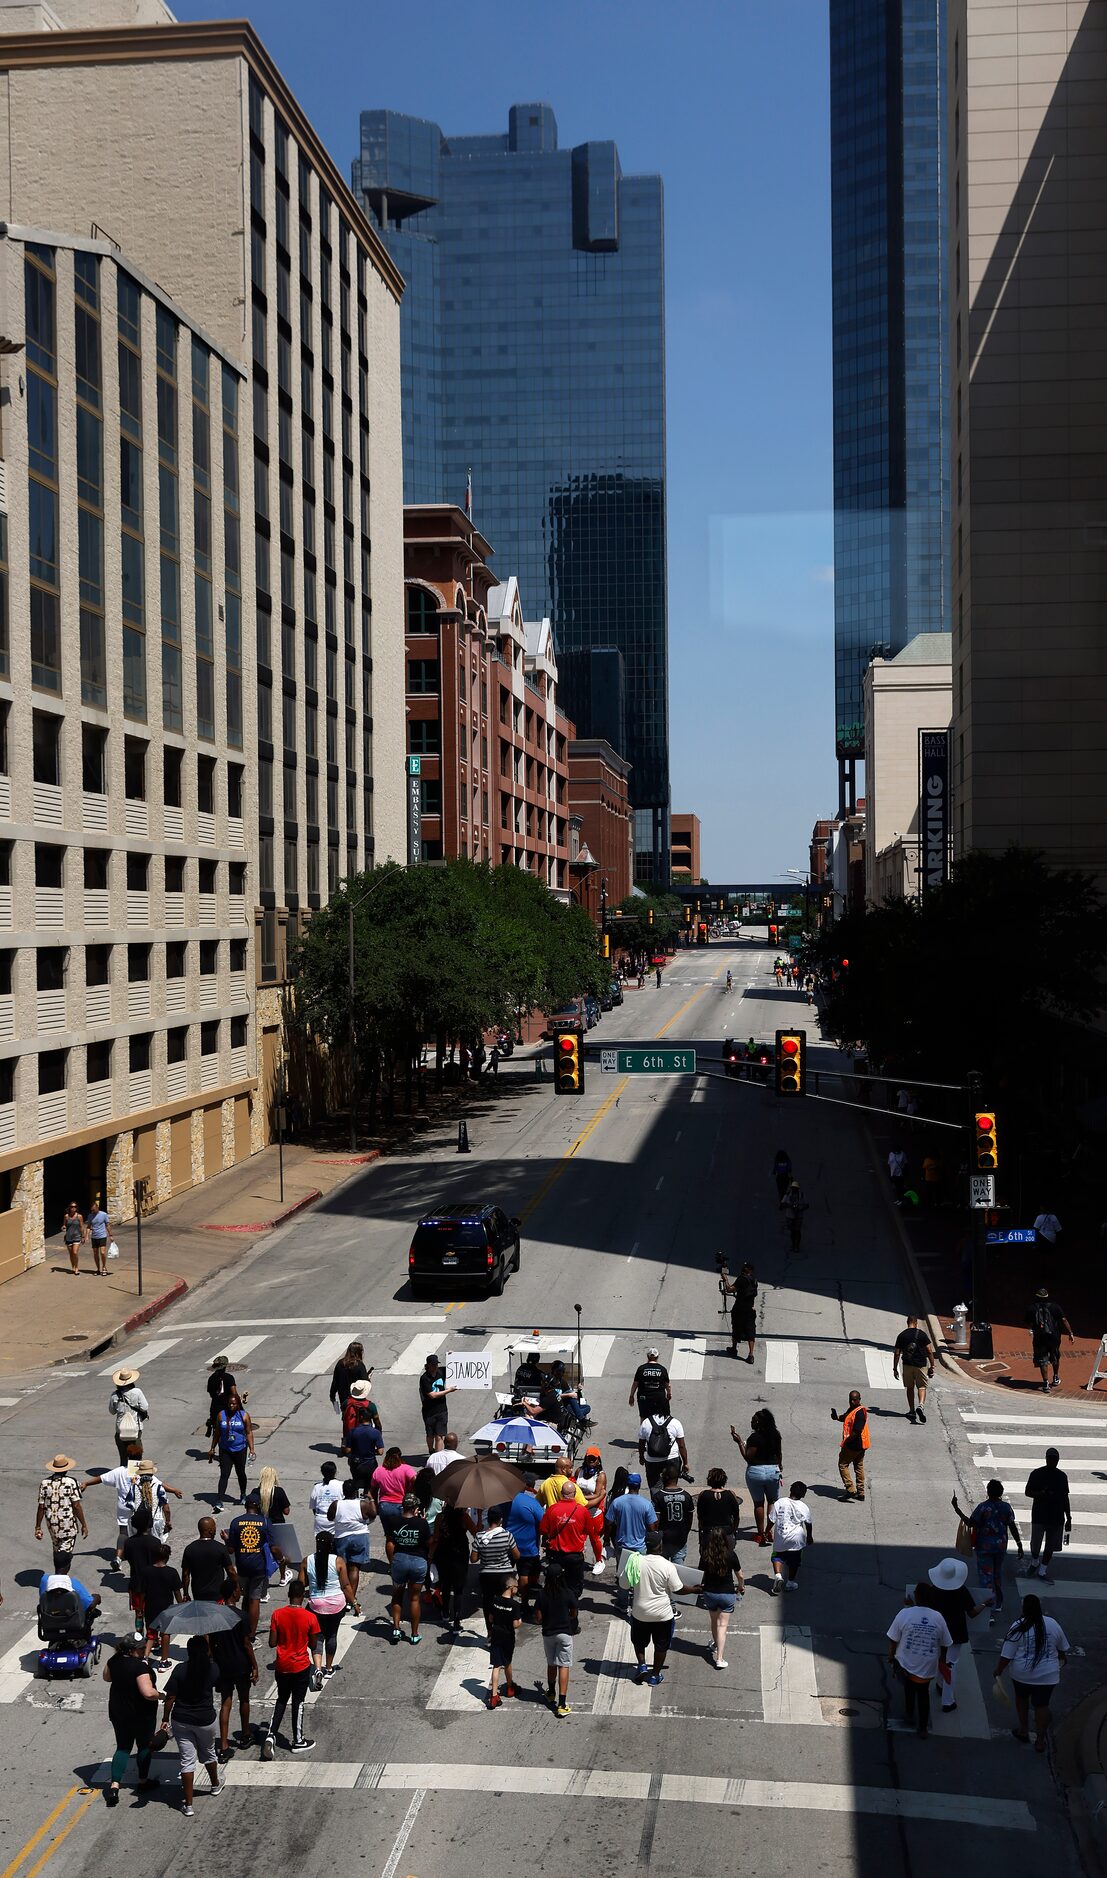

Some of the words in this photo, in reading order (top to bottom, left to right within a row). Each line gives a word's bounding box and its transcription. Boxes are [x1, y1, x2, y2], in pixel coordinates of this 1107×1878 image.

[924, 735, 946, 745] BASS
[924, 749, 946, 757] HALL
[411, 780, 420, 835] EMBASSY
[626, 1056, 633, 1068] E
[643, 1056, 664, 1068] 6th
[673, 1055, 687, 1068] St
[972, 1179, 992, 1187] ONE
[972, 1187, 992, 1196] WAY
[998, 1231, 1004, 1241] E
[1007, 1231, 1023, 1241] 6th
[446, 1361, 490, 1379] STANDBY
[666, 1501, 684, 1522] 19
[393, 1523, 420, 1539] VOTE
